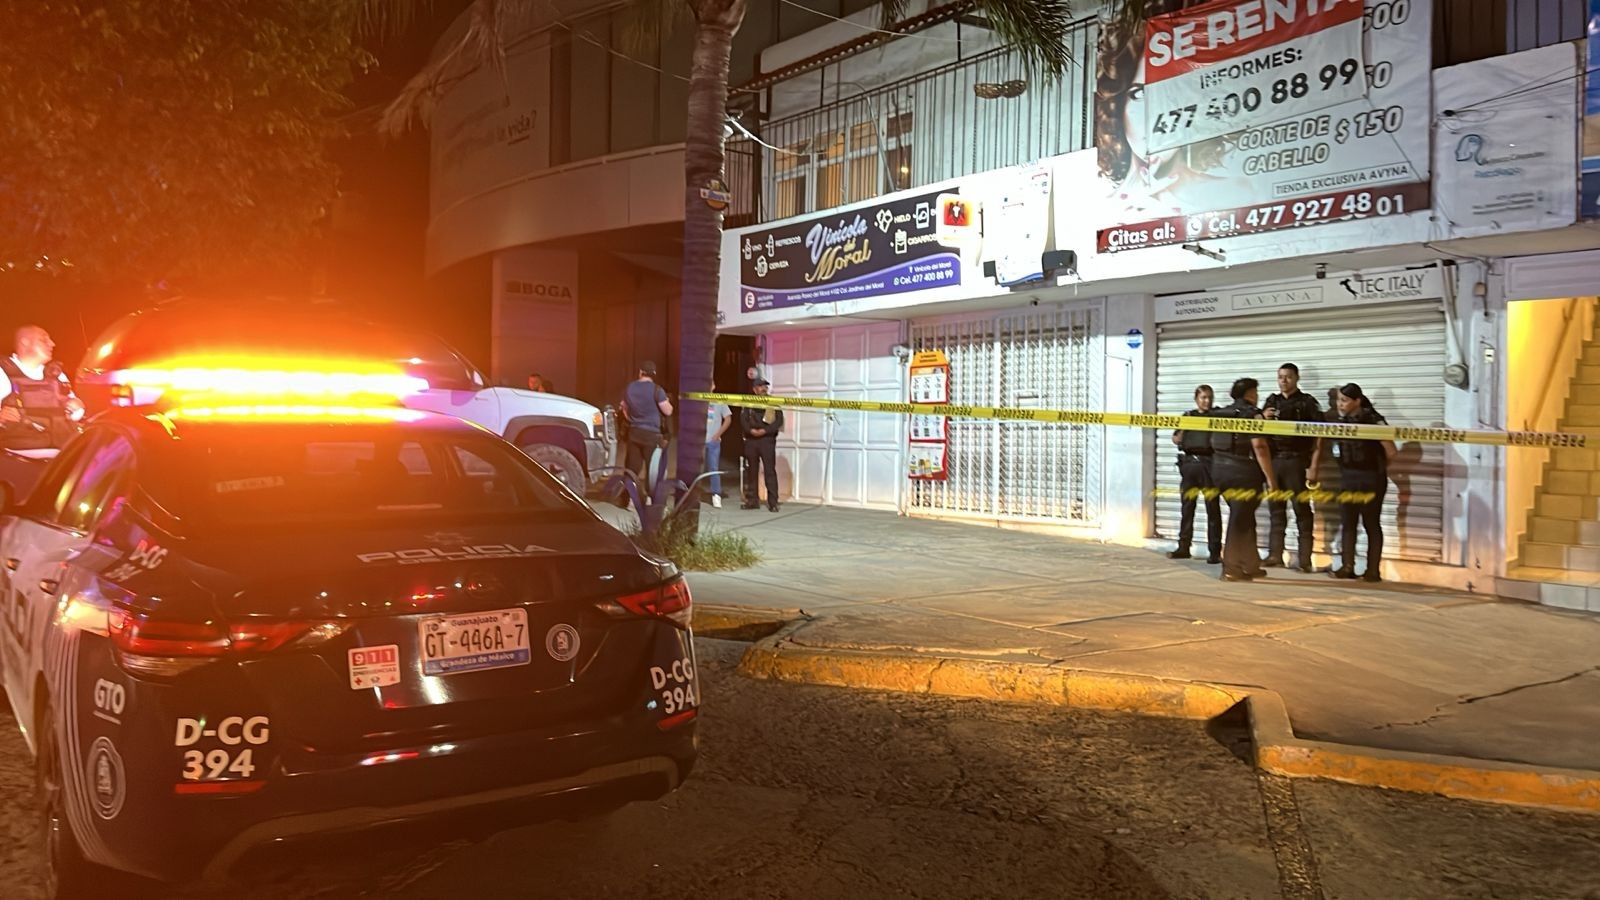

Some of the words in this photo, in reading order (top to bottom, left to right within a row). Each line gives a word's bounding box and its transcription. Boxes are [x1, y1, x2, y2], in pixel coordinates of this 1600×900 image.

[1148, 21, 1197, 68] SE
[1207, 0, 1360, 50] REN
[1200, 47, 1303, 90] INFORMES:
[1152, 104, 1198, 135] 477
[1205, 87, 1262, 120] 400
[1271, 73, 1310, 105] 88
[1319, 58, 1358, 91] 99
[1237, 122, 1299, 151] CORTE
[1301, 115, 1330, 140] DE
[1354, 105, 1404, 138] 150
[1243, 143, 1330, 175] CABELLO
[1276, 182, 1309, 195] TIENDA
[1312, 172, 1366, 188] EXCLUSIVA
[1369, 165, 1409, 180] AVYNA
[1108, 228, 1148, 247] Citas
[1153, 222, 1176, 241] al:
[1208, 215, 1240, 233] Cel.
[1246, 205, 1286, 227] 477
[1291, 197, 1335, 223] 927
[1341, 192, 1372, 212] 48
[1376, 194, 1405, 216] 01
[806, 214, 868, 265] Vinícola
[805, 238, 872, 283] Moral
[522, 282, 573, 299] BOGA
[1359, 277, 1384, 294] TEC
[1389, 274, 1425, 291] ITALY
[1057, 411, 1105, 424] PRECAUCION
[1129, 414, 1181, 428] PRECAUCION
[1208, 417, 1265, 432] PRECAUCION
[1295, 421, 1359, 437] PRECAUCION
[1393, 426, 1467, 442] PRECAUCION
[1505, 431, 1586, 448] PRECAUCION
[356, 544, 559, 563] POLICIA
[451, 616, 498, 626] Guanajuato
[425, 623, 524, 658] GT-446A-7
[354, 650, 392, 665] 911
[650, 657, 694, 690] D-CG
[94, 678, 126, 714] GTO
[662, 683, 696, 714] 394
[174, 716, 270, 746] D-CG
[182, 749, 256, 780] 394
